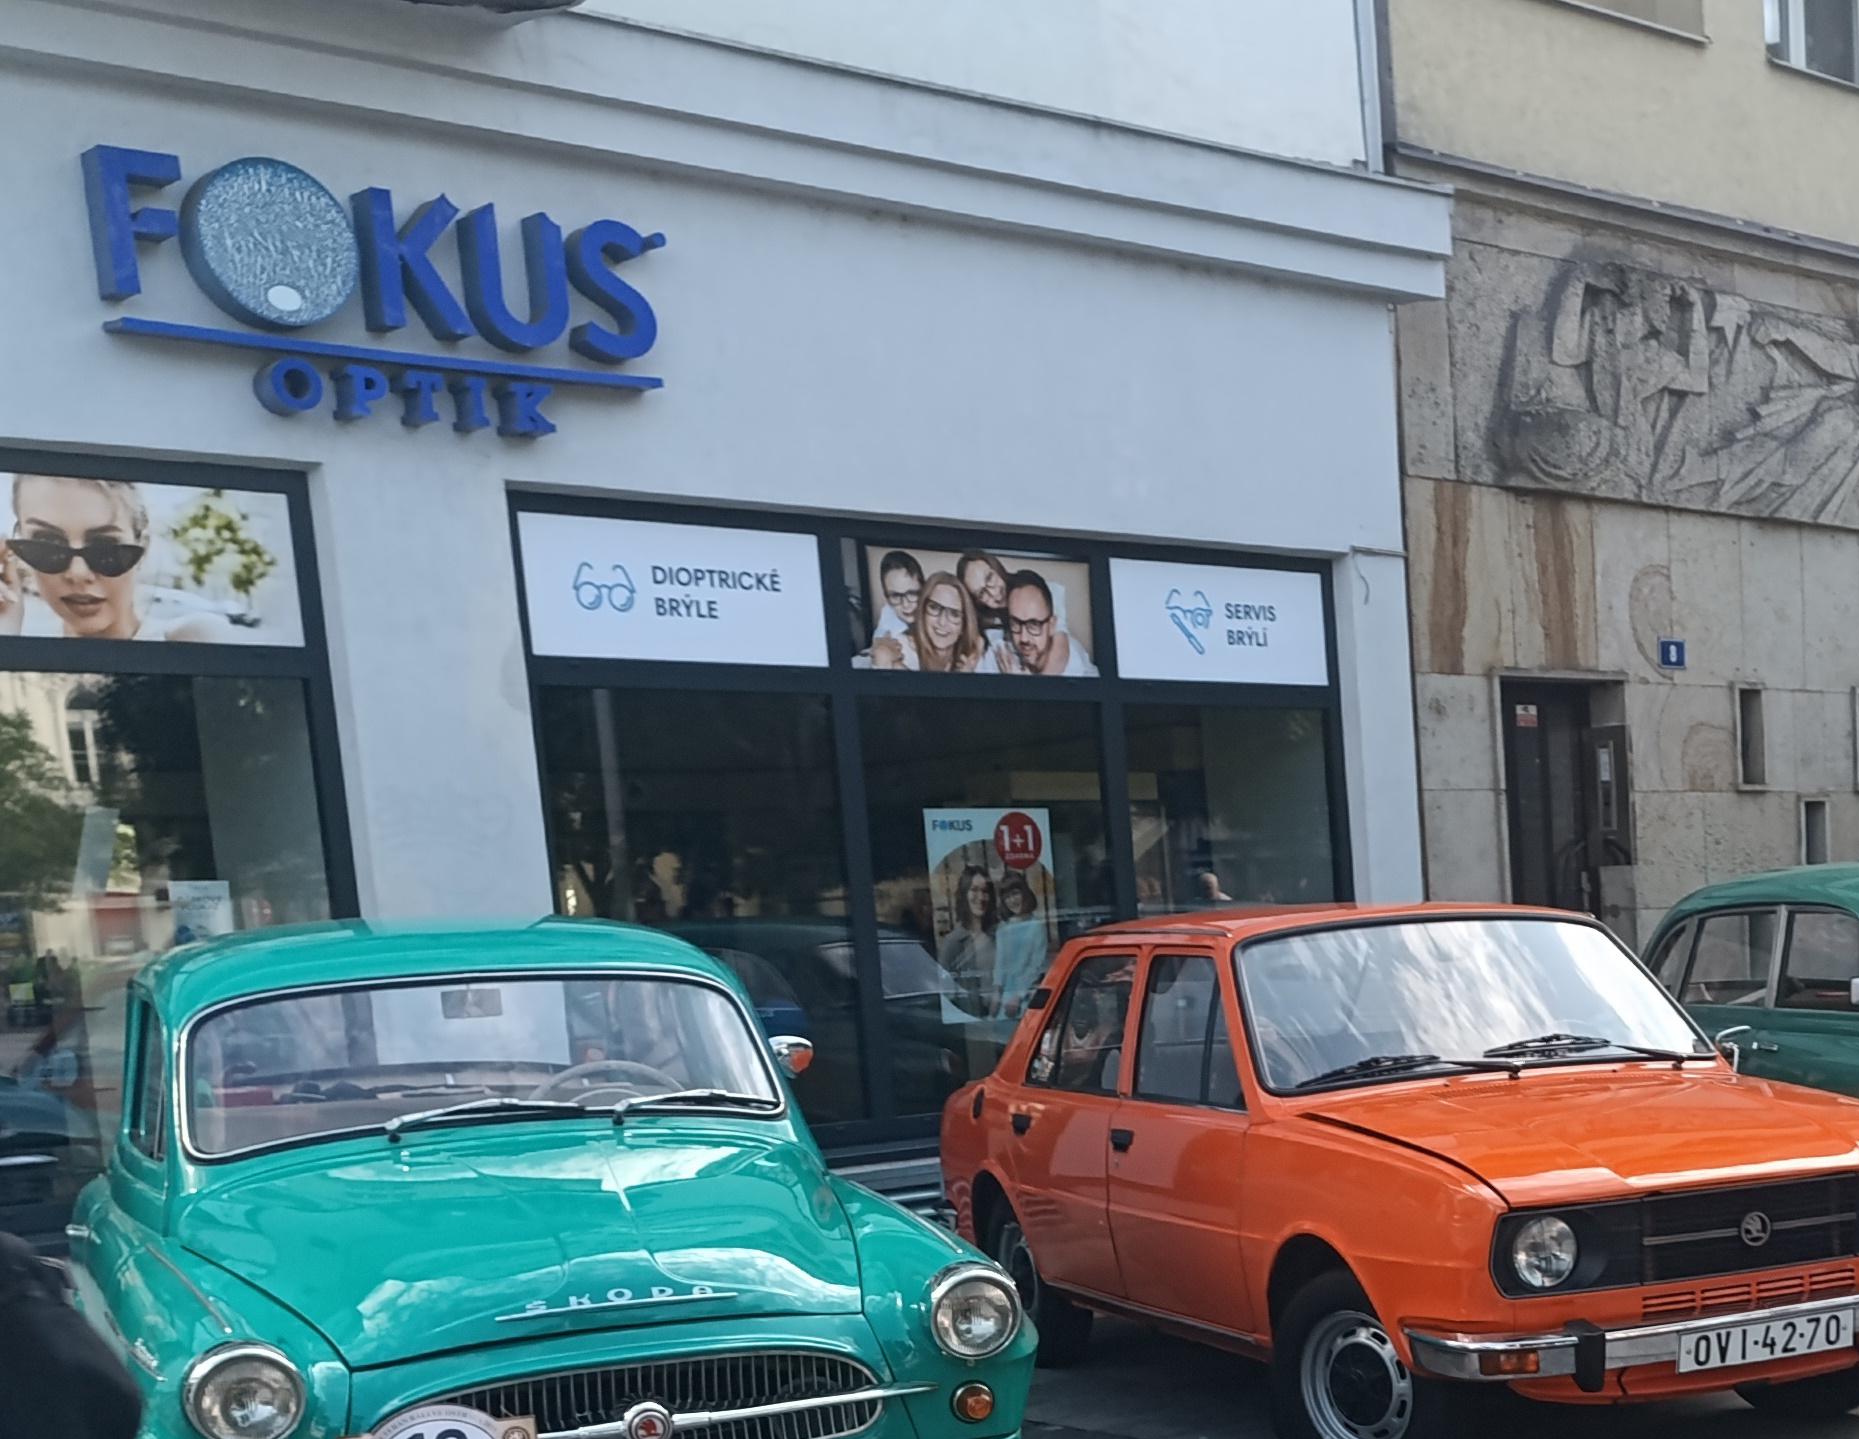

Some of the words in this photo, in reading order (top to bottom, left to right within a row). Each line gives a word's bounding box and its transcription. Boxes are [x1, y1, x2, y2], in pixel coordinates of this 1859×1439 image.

[81, 144, 666, 365] FOKUS
[253, 357, 557, 438] OPTIK
[651, 565, 782, 592] DIOPTRICKÉ
[654, 594, 719, 619] BRÝLE
[1224, 602, 1277, 622] SERVIS
[931, 819, 973, 832] FOKUS
[999, 824, 1035, 852] 1+1
